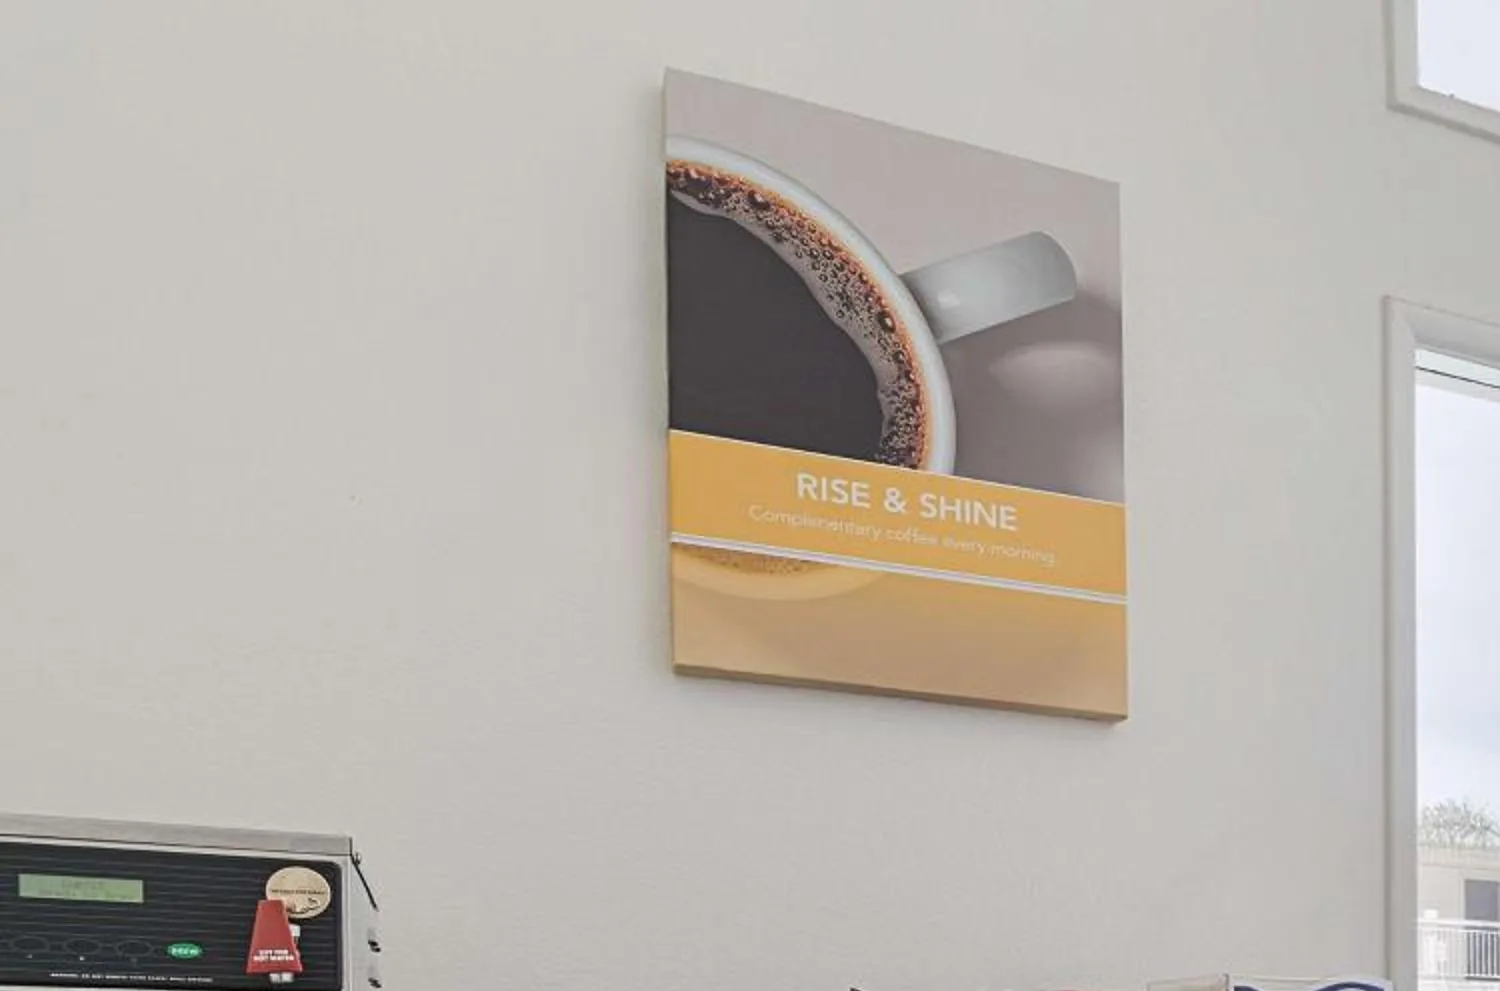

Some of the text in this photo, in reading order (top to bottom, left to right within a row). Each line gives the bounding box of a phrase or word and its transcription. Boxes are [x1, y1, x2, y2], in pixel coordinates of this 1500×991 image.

[750, 504, 881, 541] Complimentary
[886, 526, 938, 547] coffee
[943, 537, 987, 556] every
[796, 472, 1017, 532] RISE & SHINE
